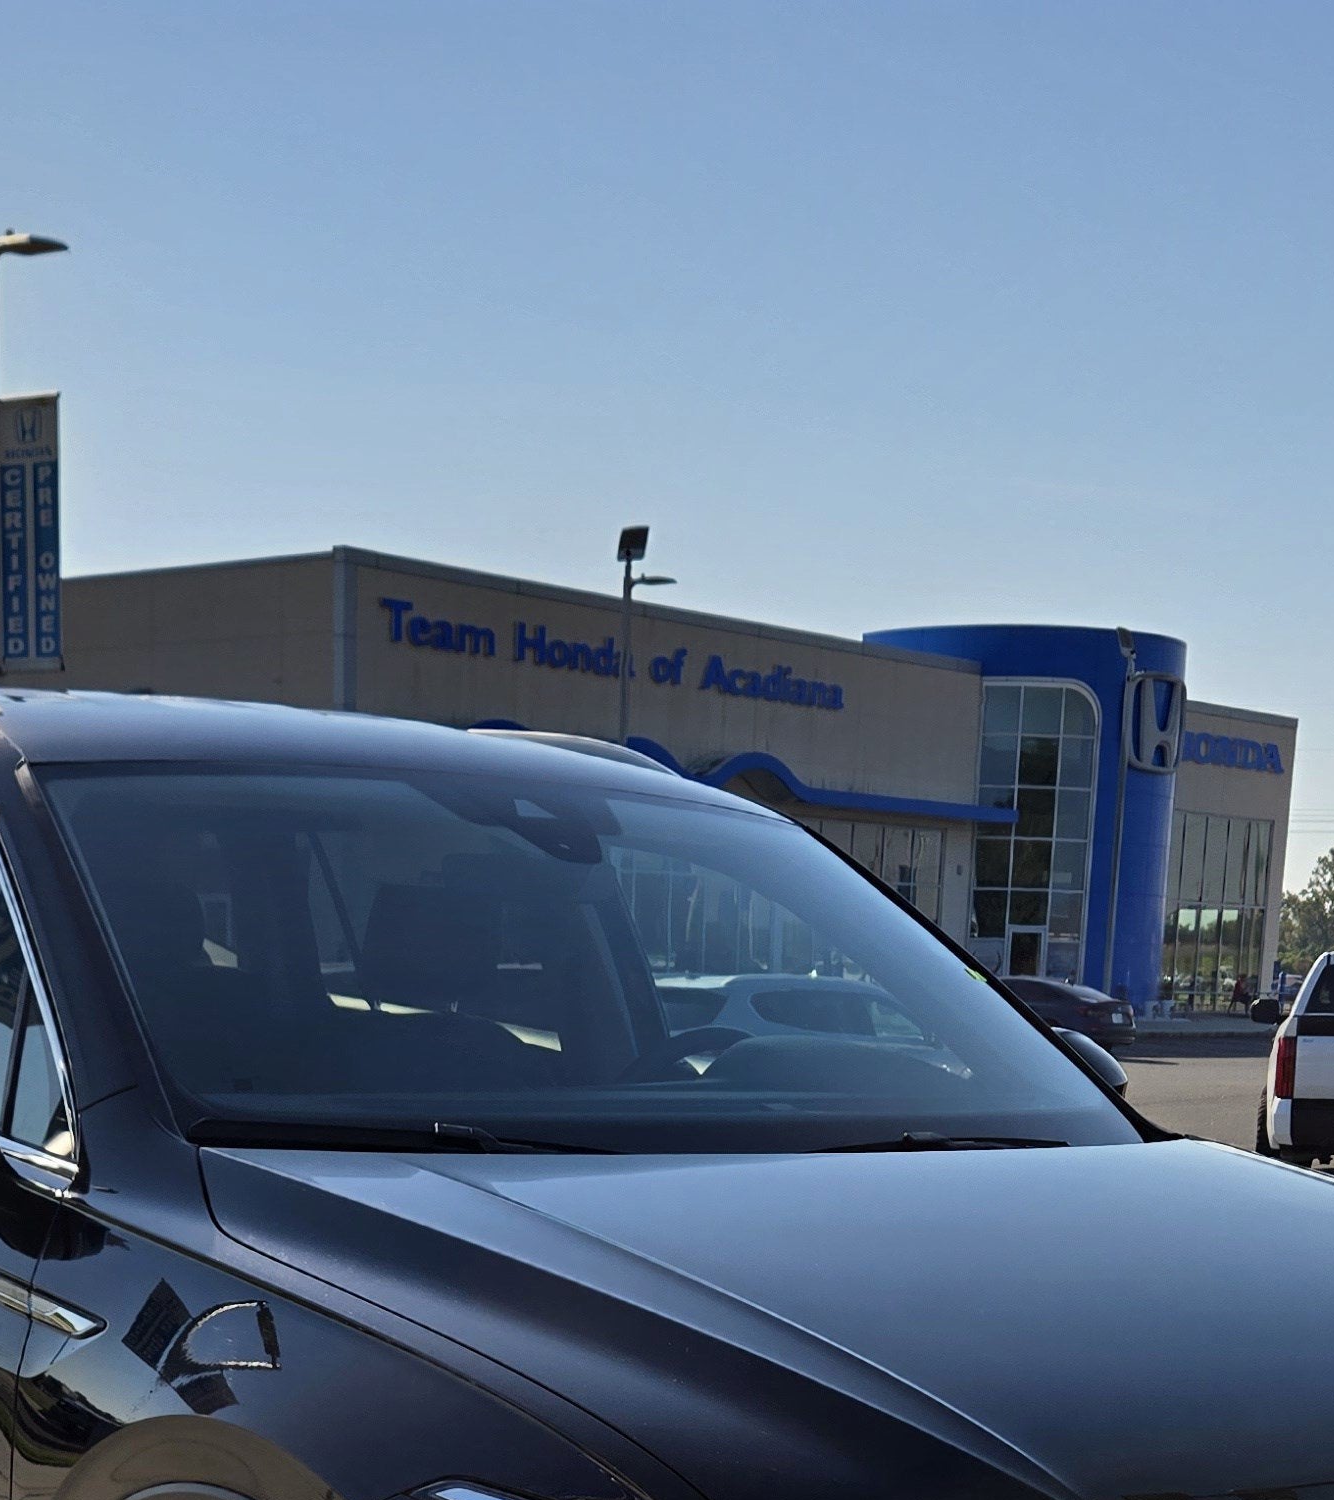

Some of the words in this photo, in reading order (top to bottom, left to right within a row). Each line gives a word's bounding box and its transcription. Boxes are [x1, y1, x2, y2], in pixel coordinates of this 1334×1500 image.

[4, 468, 25, 654] CERTIFIED
[38, 551, 56, 654] OWNED
[379, 597, 496, 658] Team
[513, 621, 636, 679] Honda
[650, 647, 688, 686] of
[699, 654, 845, 710] Acadiana
